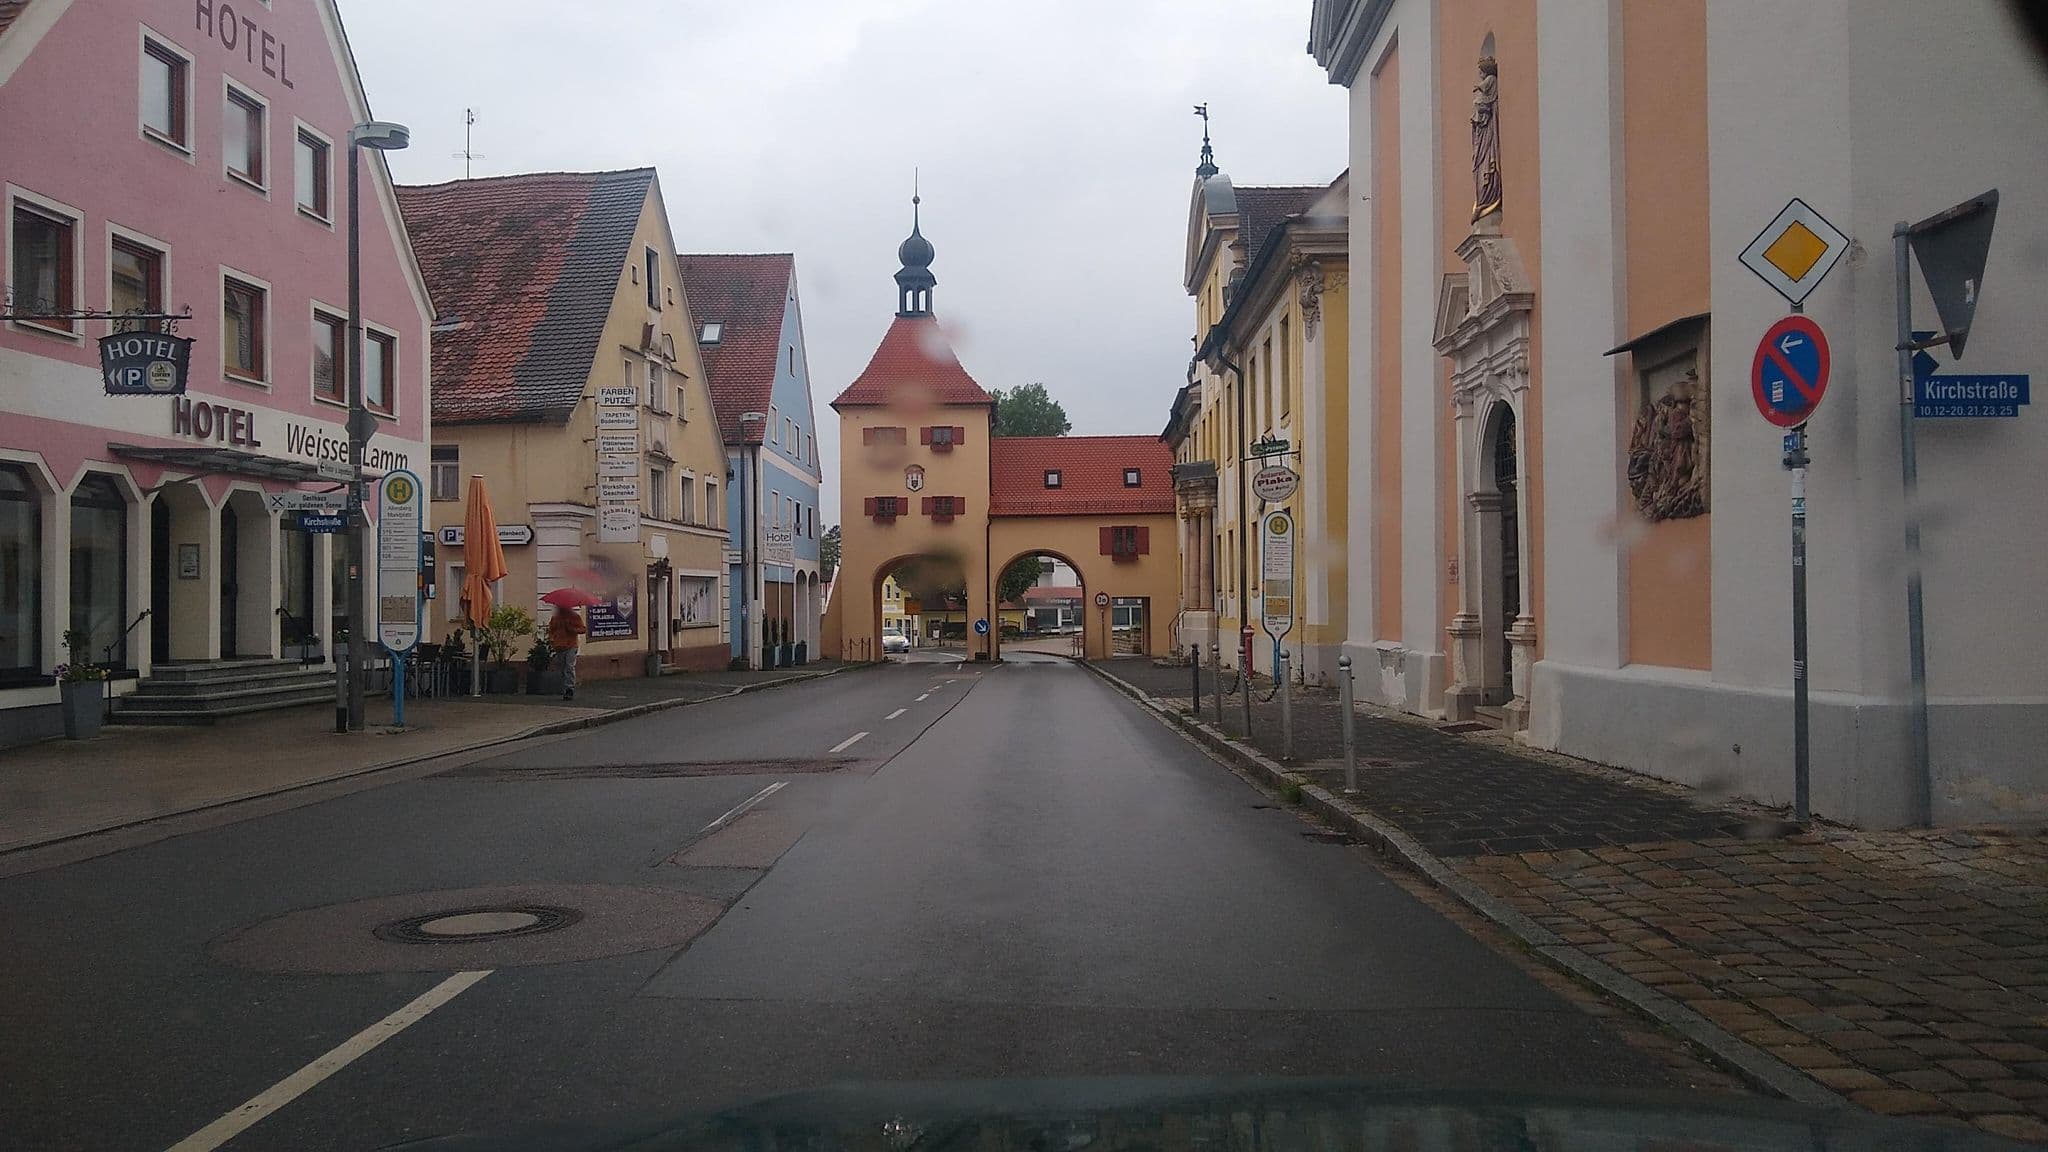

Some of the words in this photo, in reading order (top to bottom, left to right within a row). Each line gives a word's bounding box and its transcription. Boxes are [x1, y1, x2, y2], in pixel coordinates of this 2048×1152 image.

[196, 0, 293, 89] HOTEL
[107, 338, 177, 360] HOTEL
[127, 369, 141, 385] P
[1925, 381, 2018, 399] Kirchstraße
[174, 396, 261, 447] HOTEL
[286, 423, 349, 463] Weisse
[362, 445, 409, 472] Lamm
[1257, 477, 1293, 487] Plaka
[303, 518, 342, 526] Kirchstraße
[447, 531, 455, 541] P
[766, 532, 792, 542] Hotel
